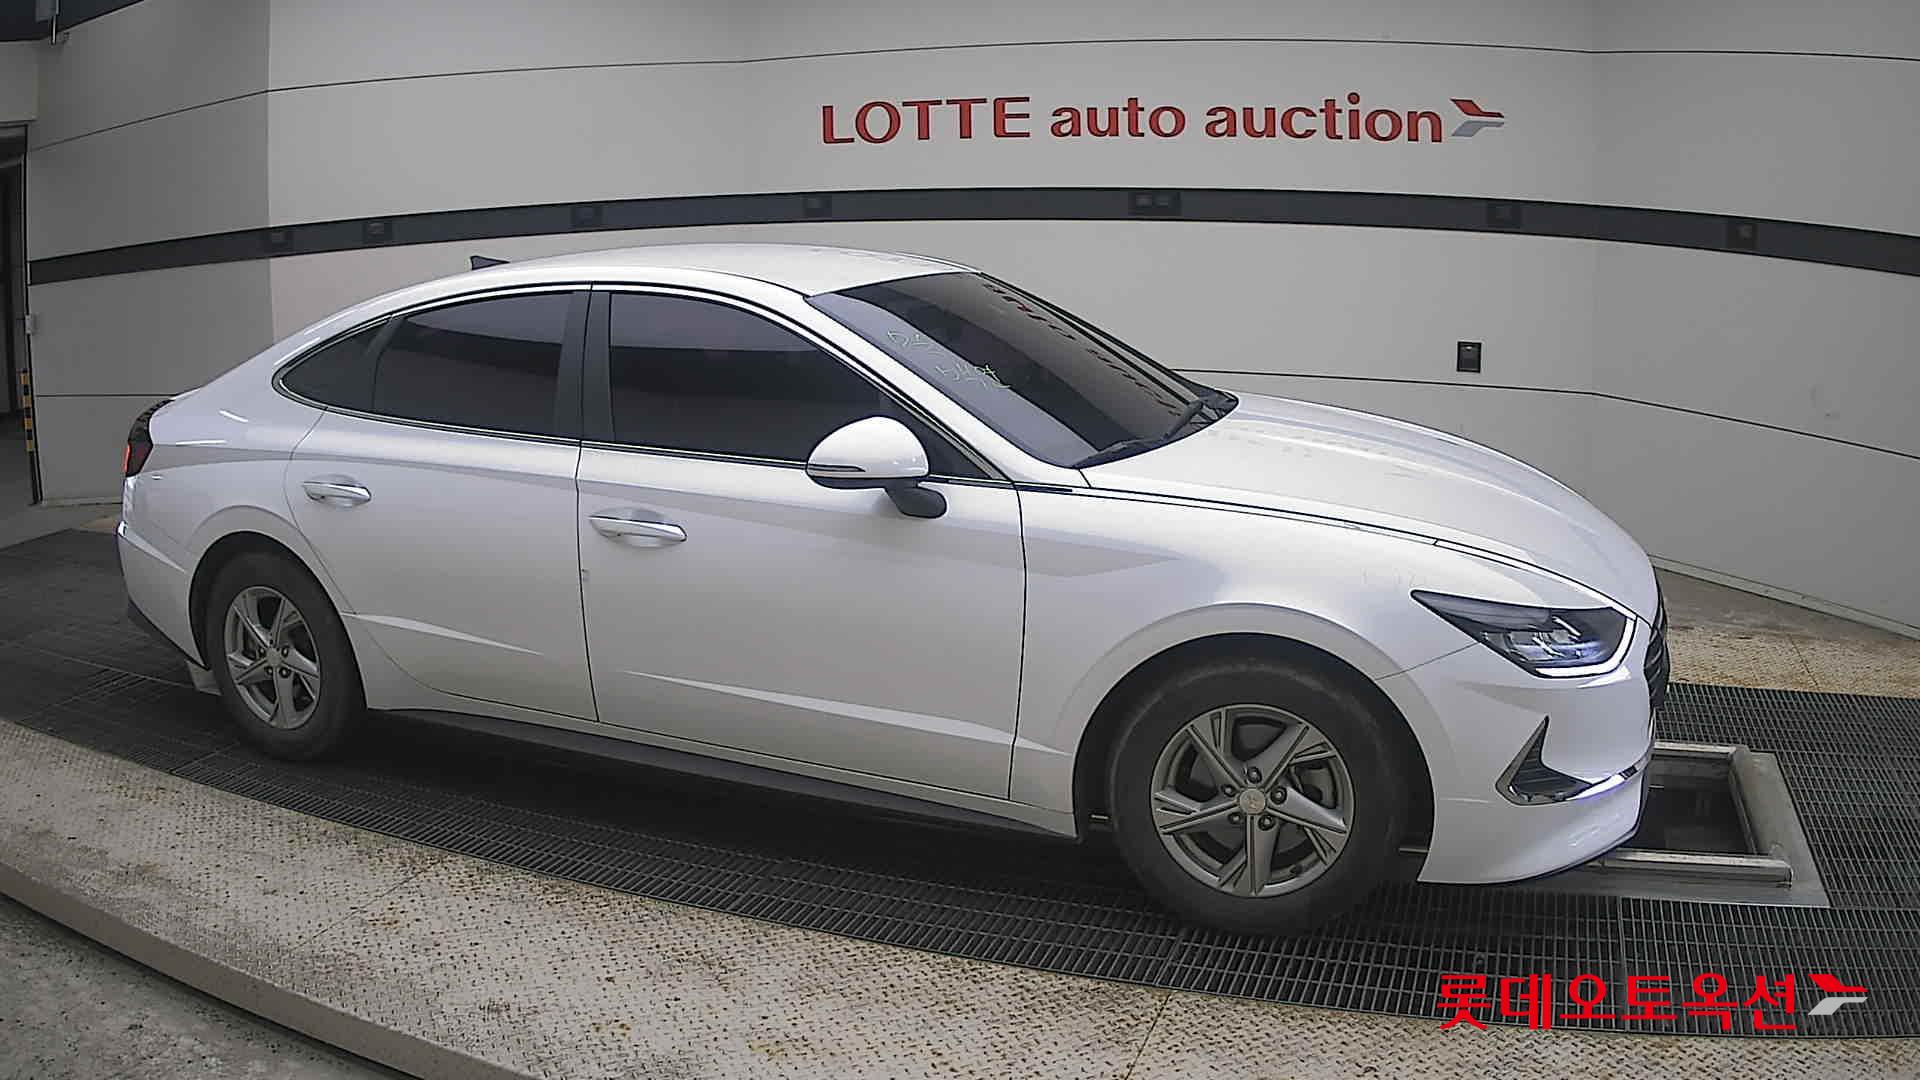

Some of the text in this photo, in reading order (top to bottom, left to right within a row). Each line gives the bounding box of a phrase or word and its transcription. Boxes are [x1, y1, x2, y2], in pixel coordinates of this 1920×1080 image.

[822, 93, 1444, 145] LOTTE auto auction
